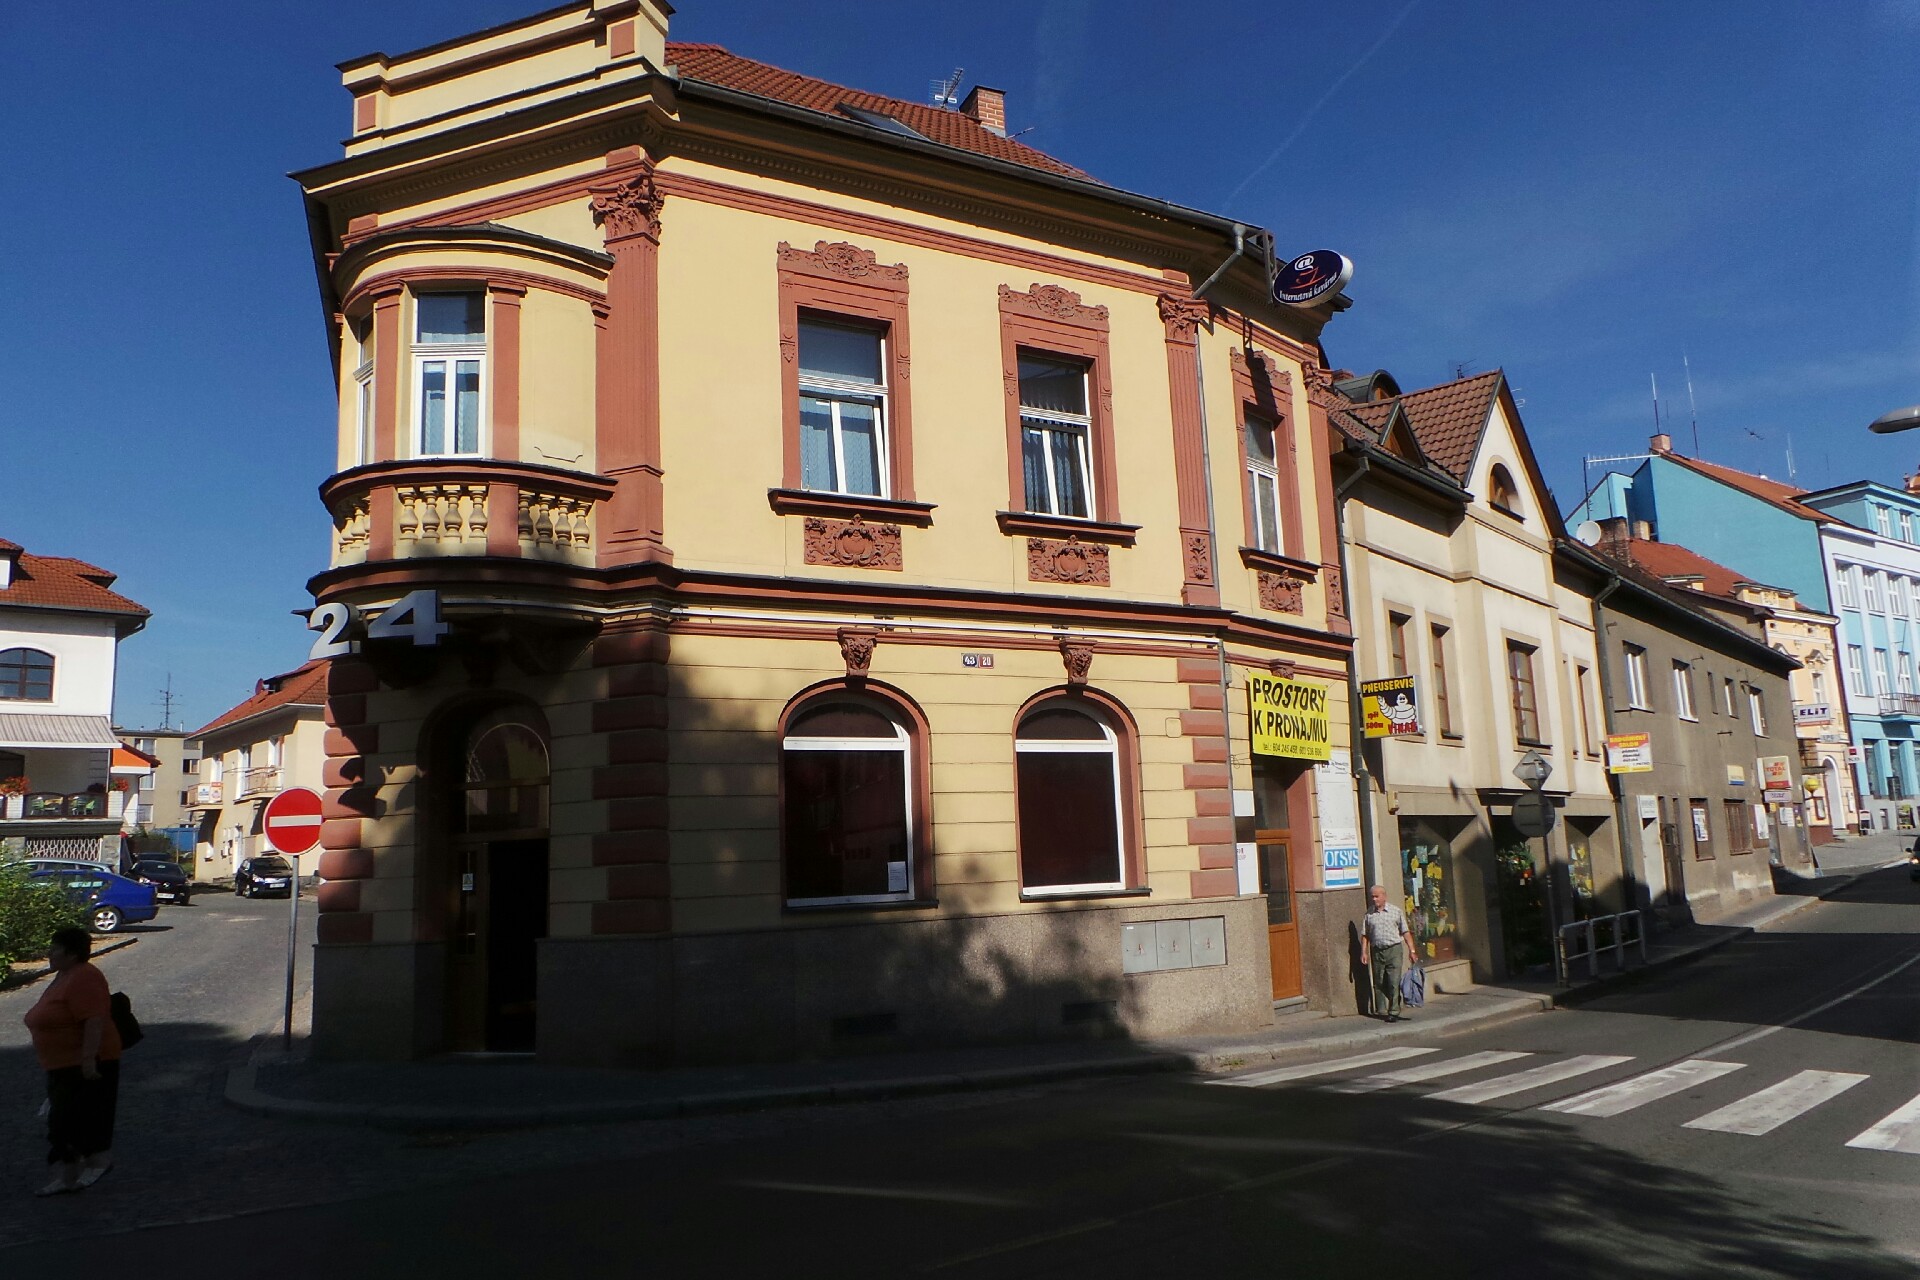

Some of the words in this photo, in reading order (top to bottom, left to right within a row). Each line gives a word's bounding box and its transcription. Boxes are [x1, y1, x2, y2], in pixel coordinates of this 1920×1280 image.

[964, 656, 976, 665] 43
[1252, 677, 1326, 713] PROSTORY
[1362, 677, 1415, 694] PNEUSERVIS
[1253, 709, 1264, 736] K
[1266, 710, 1328, 744] PRONÁJMU
